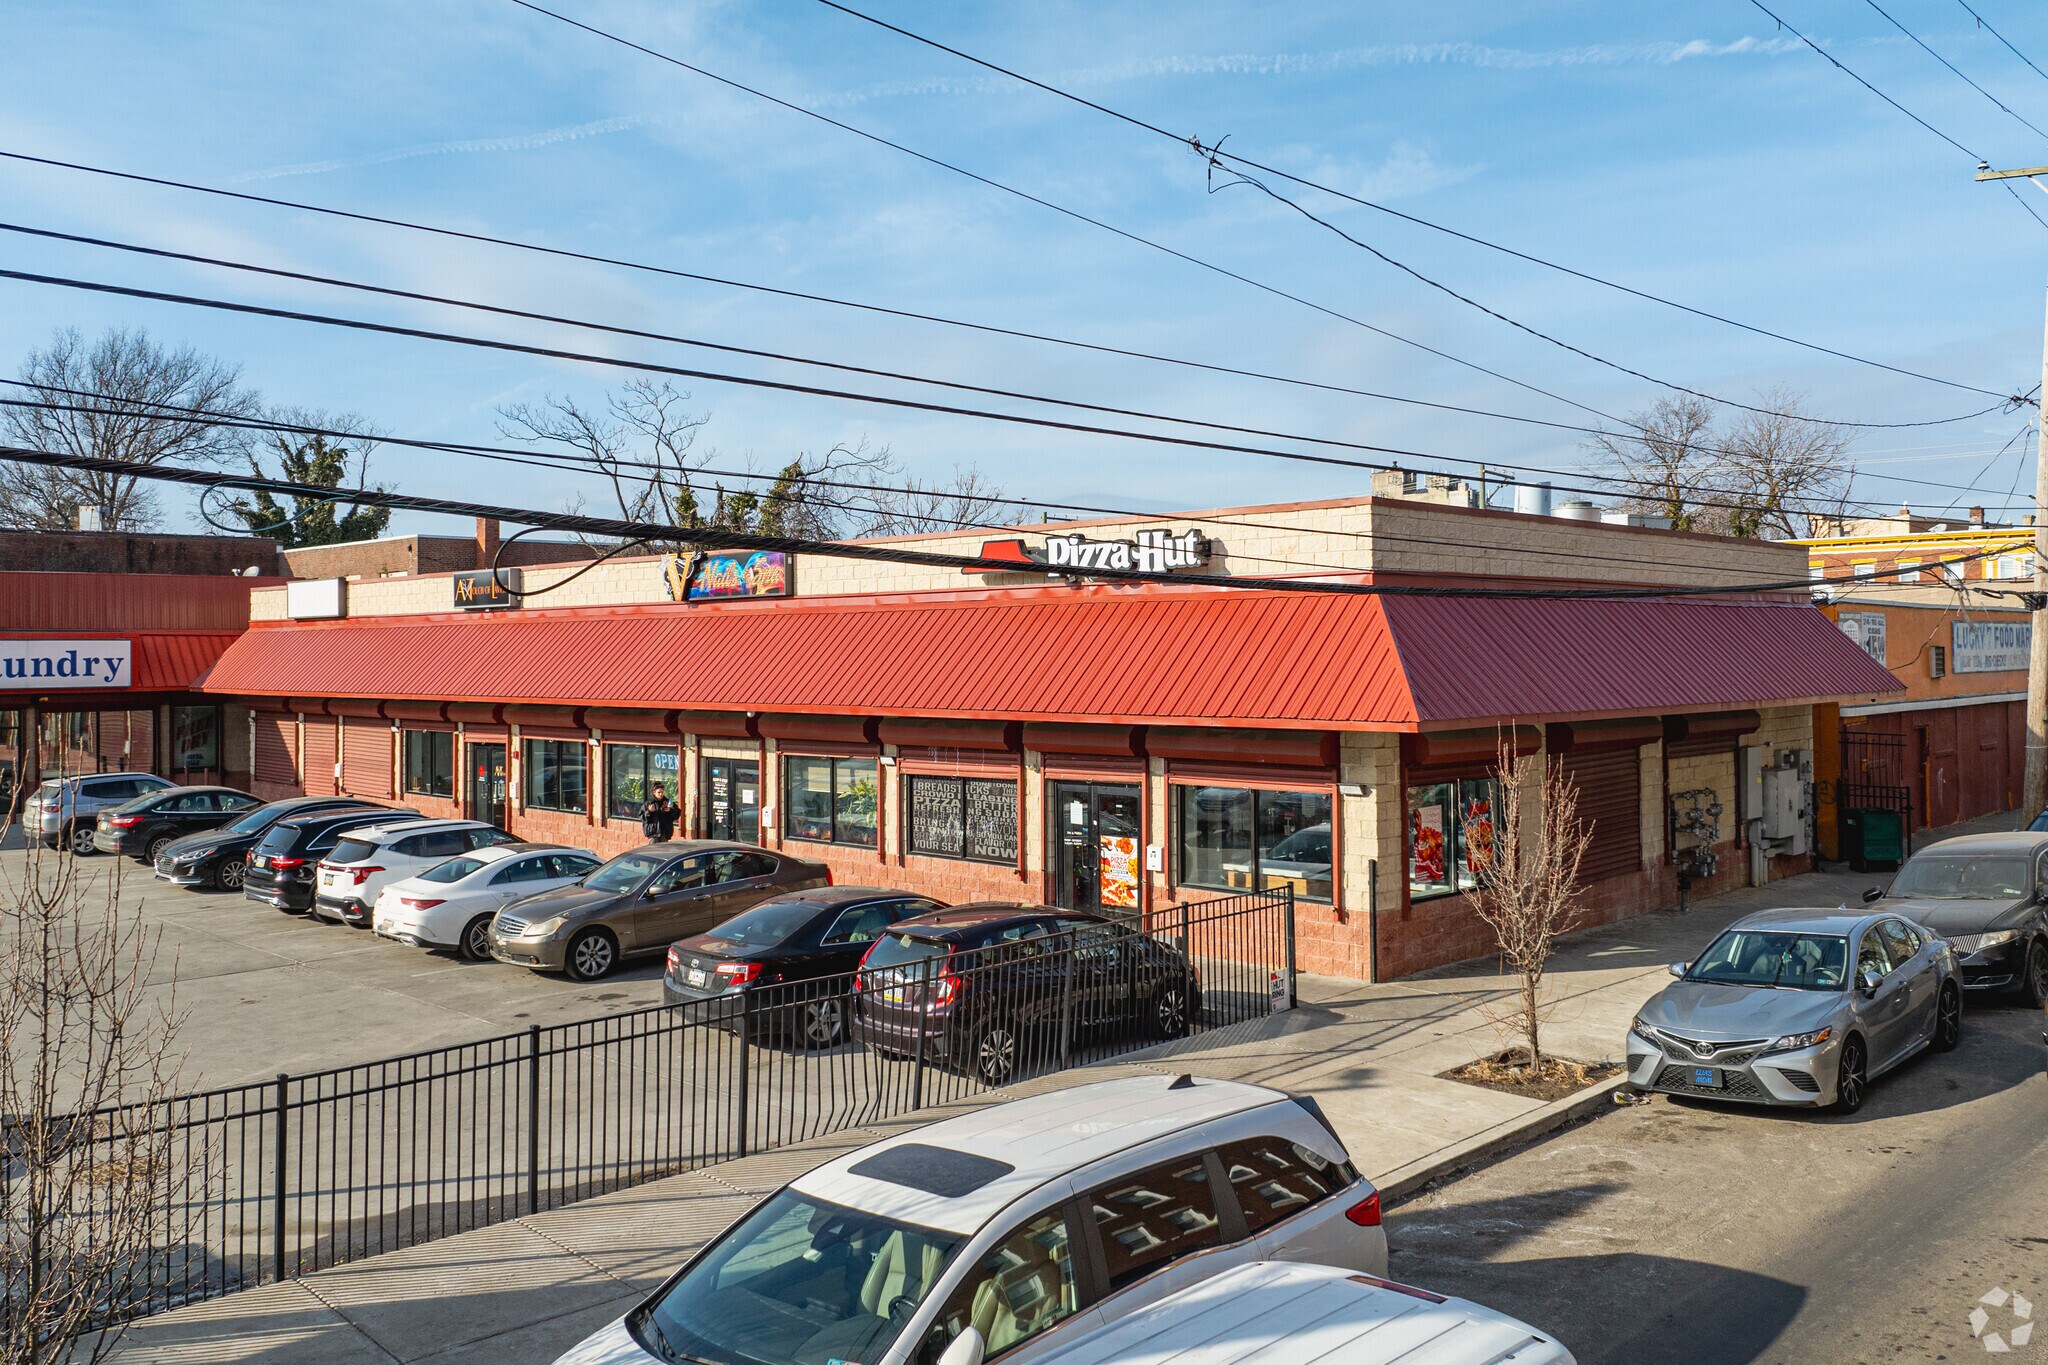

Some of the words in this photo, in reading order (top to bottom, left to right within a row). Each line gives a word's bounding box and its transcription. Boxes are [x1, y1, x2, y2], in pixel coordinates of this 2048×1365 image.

[1047, 536, 1130, 577] Pizza
[1131, 529, 1197, 573] Hut
[699, 560, 739, 591] Nails
[1994, 626, 2014, 649] FOOD
[2015, 626, 2032, 649] MAR
[0, 649, 125, 683] undry
[654, 753, 679, 770] OPEN
[913, 789, 955, 799] CROWD
[913, 796, 961, 808] PIZZA
[974, 800, 1018, 812] BETTER
[985, 809, 1018, 819] SODA
[913, 817, 945, 828] BRING
[914, 839, 939, 850] YOUR
[974, 837, 1005, 848] FLAVOR
[974, 844, 1019, 859] NOW
[1110, 856, 1128, 864] PIZZA
